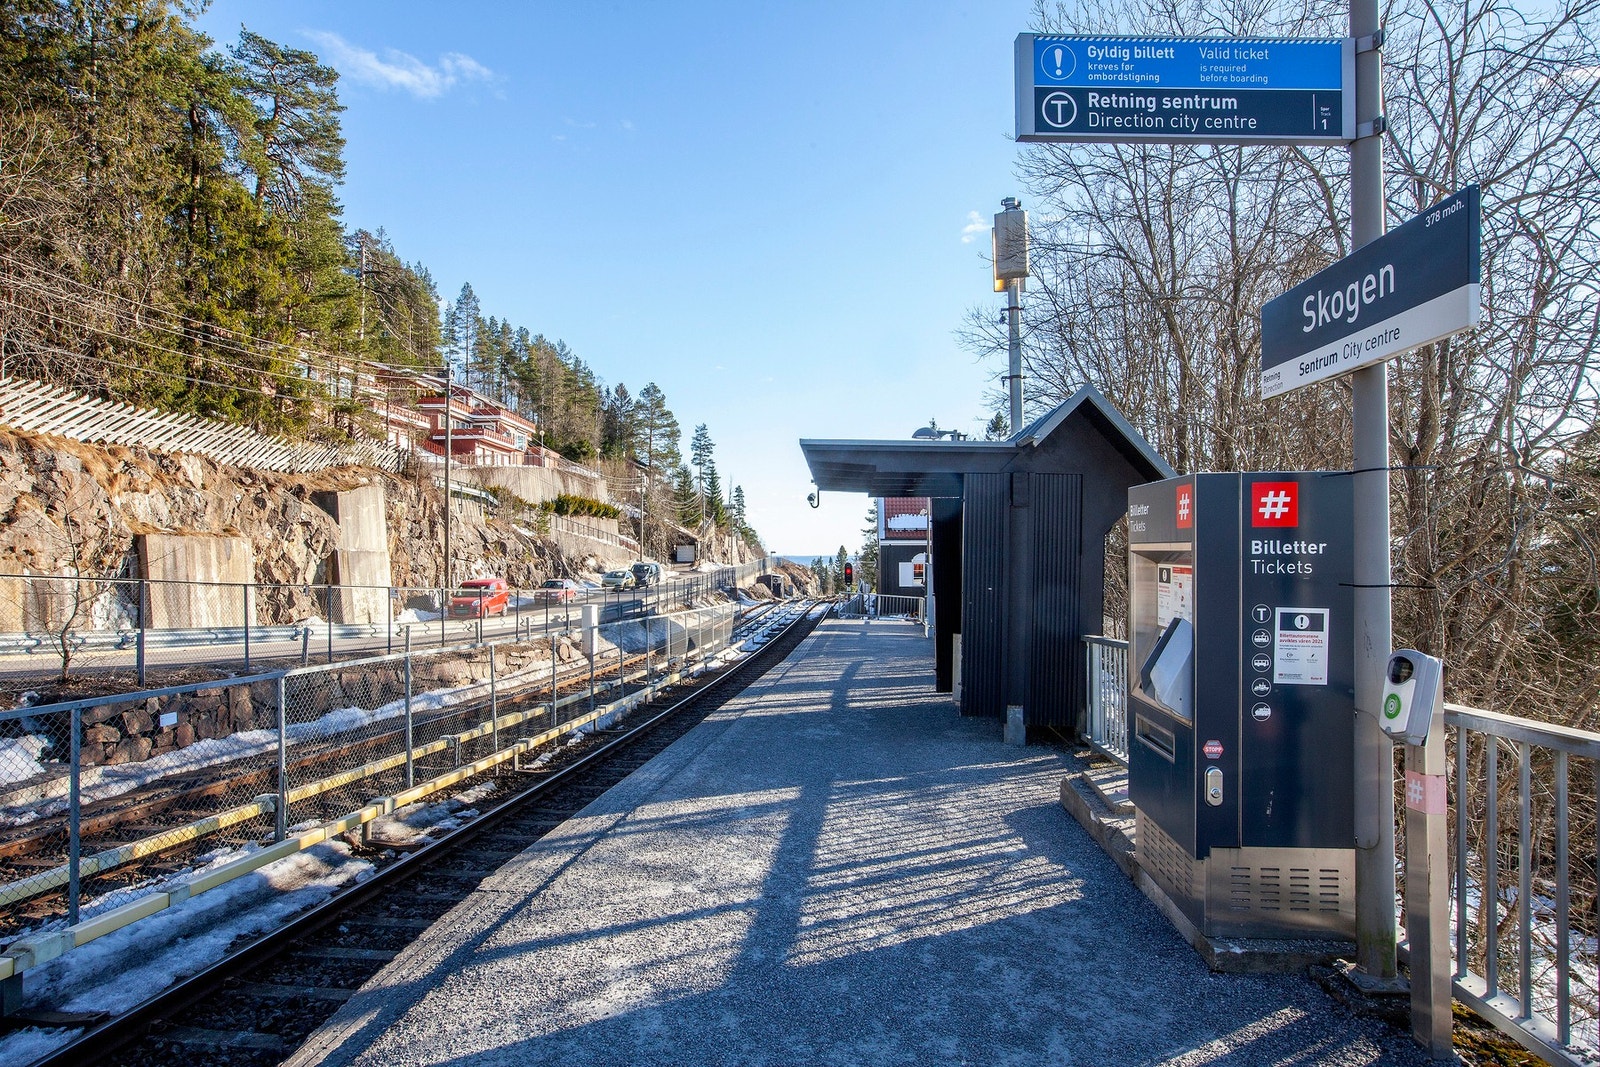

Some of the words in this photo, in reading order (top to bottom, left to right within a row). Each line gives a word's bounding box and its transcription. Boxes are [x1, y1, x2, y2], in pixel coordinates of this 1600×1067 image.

[1087, 46, 1130, 60] Gyldig
[1134, 46, 1175, 59] billett
[1199, 47, 1230, 60] Valid
[1234, 48, 1269, 60] ticket
[1087, 62, 1119, 71] kreves
[1121, 62, 1135, 71] før
[1200, 64, 1207, 72] is
[1210, 64, 1246, 73] required
[1087, 72, 1160, 83] ombordstigning
[1200, 74, 1228, 82] before
[1230, 74, 1268, 85] boarding
[1088, 92, 1157, 112] Retning
[1162, 94, 1238, 110] sentrum
[1088, 112, 1164, 128] Direction
[1170, 113, 1199, 132] city
[1204, 115, 1257, 129] centre
[1321, 118, 1327, 130] 1
[1425, 209, 1441, 228] 378
[1442, 199, 1465, 219] moh.
[1302, 263, 1395, 333] Skogen
[1299, 352, 1338, 376] Sentrum
[1343, 341, 1363, 360] City
[1365, 326, 1400, 351] centre
[1263, 370, 1281, 384] Retning
[1129, 503, 1150, 517] Billetter
[1129, 520, 1146, 532] Tickets
[1251, 540, 1327, 554] Billetter
[1251, 559, 1313, 574] Tickets
